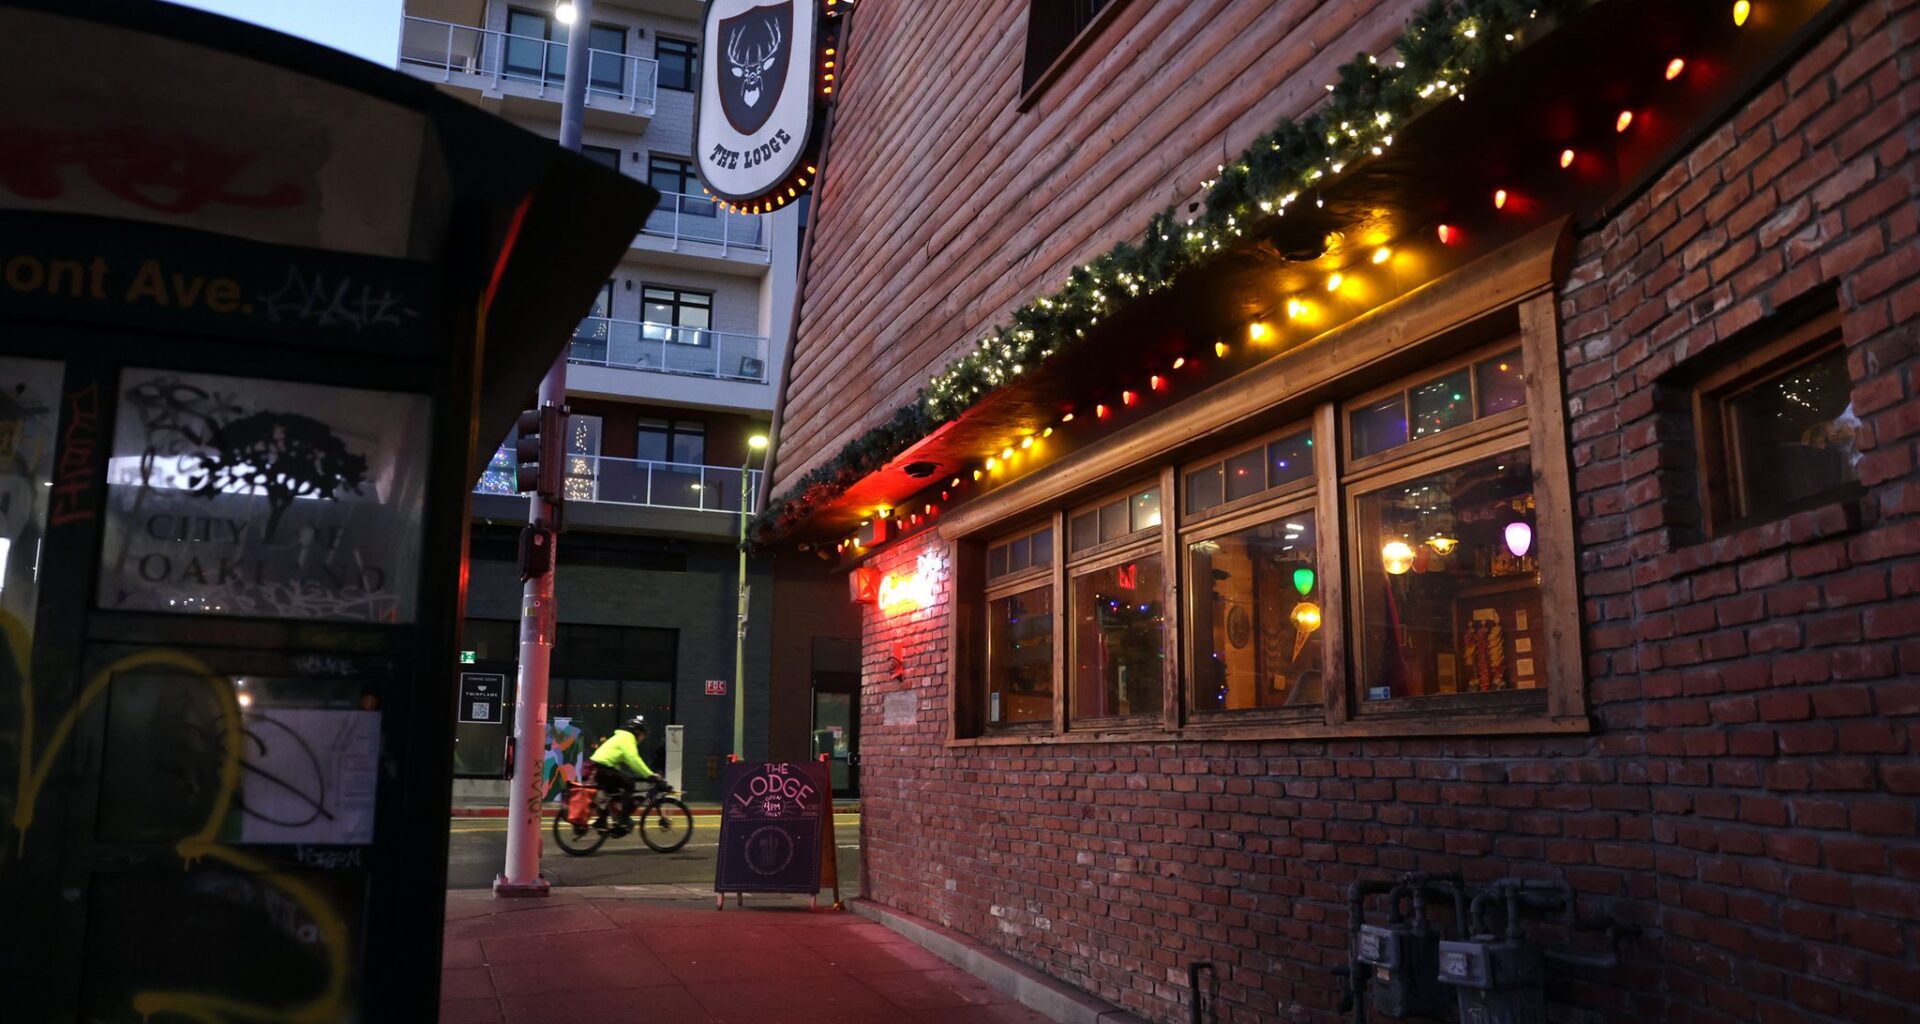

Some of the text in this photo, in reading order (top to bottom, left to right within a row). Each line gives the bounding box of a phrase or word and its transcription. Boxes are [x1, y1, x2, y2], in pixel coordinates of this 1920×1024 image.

[708, 128, 791, 170] THE LODGE
[0, 254, 112, 300] ont
[123, 258, 255, 317] Ave.
[146, 513, 248, 545] CITY
[138, 553, 386, 593] OAKLND
[708, 680, 724, 690] FDC
[764, 762, 789, 775] THE
[733, 774, 814, 810] LODGE
